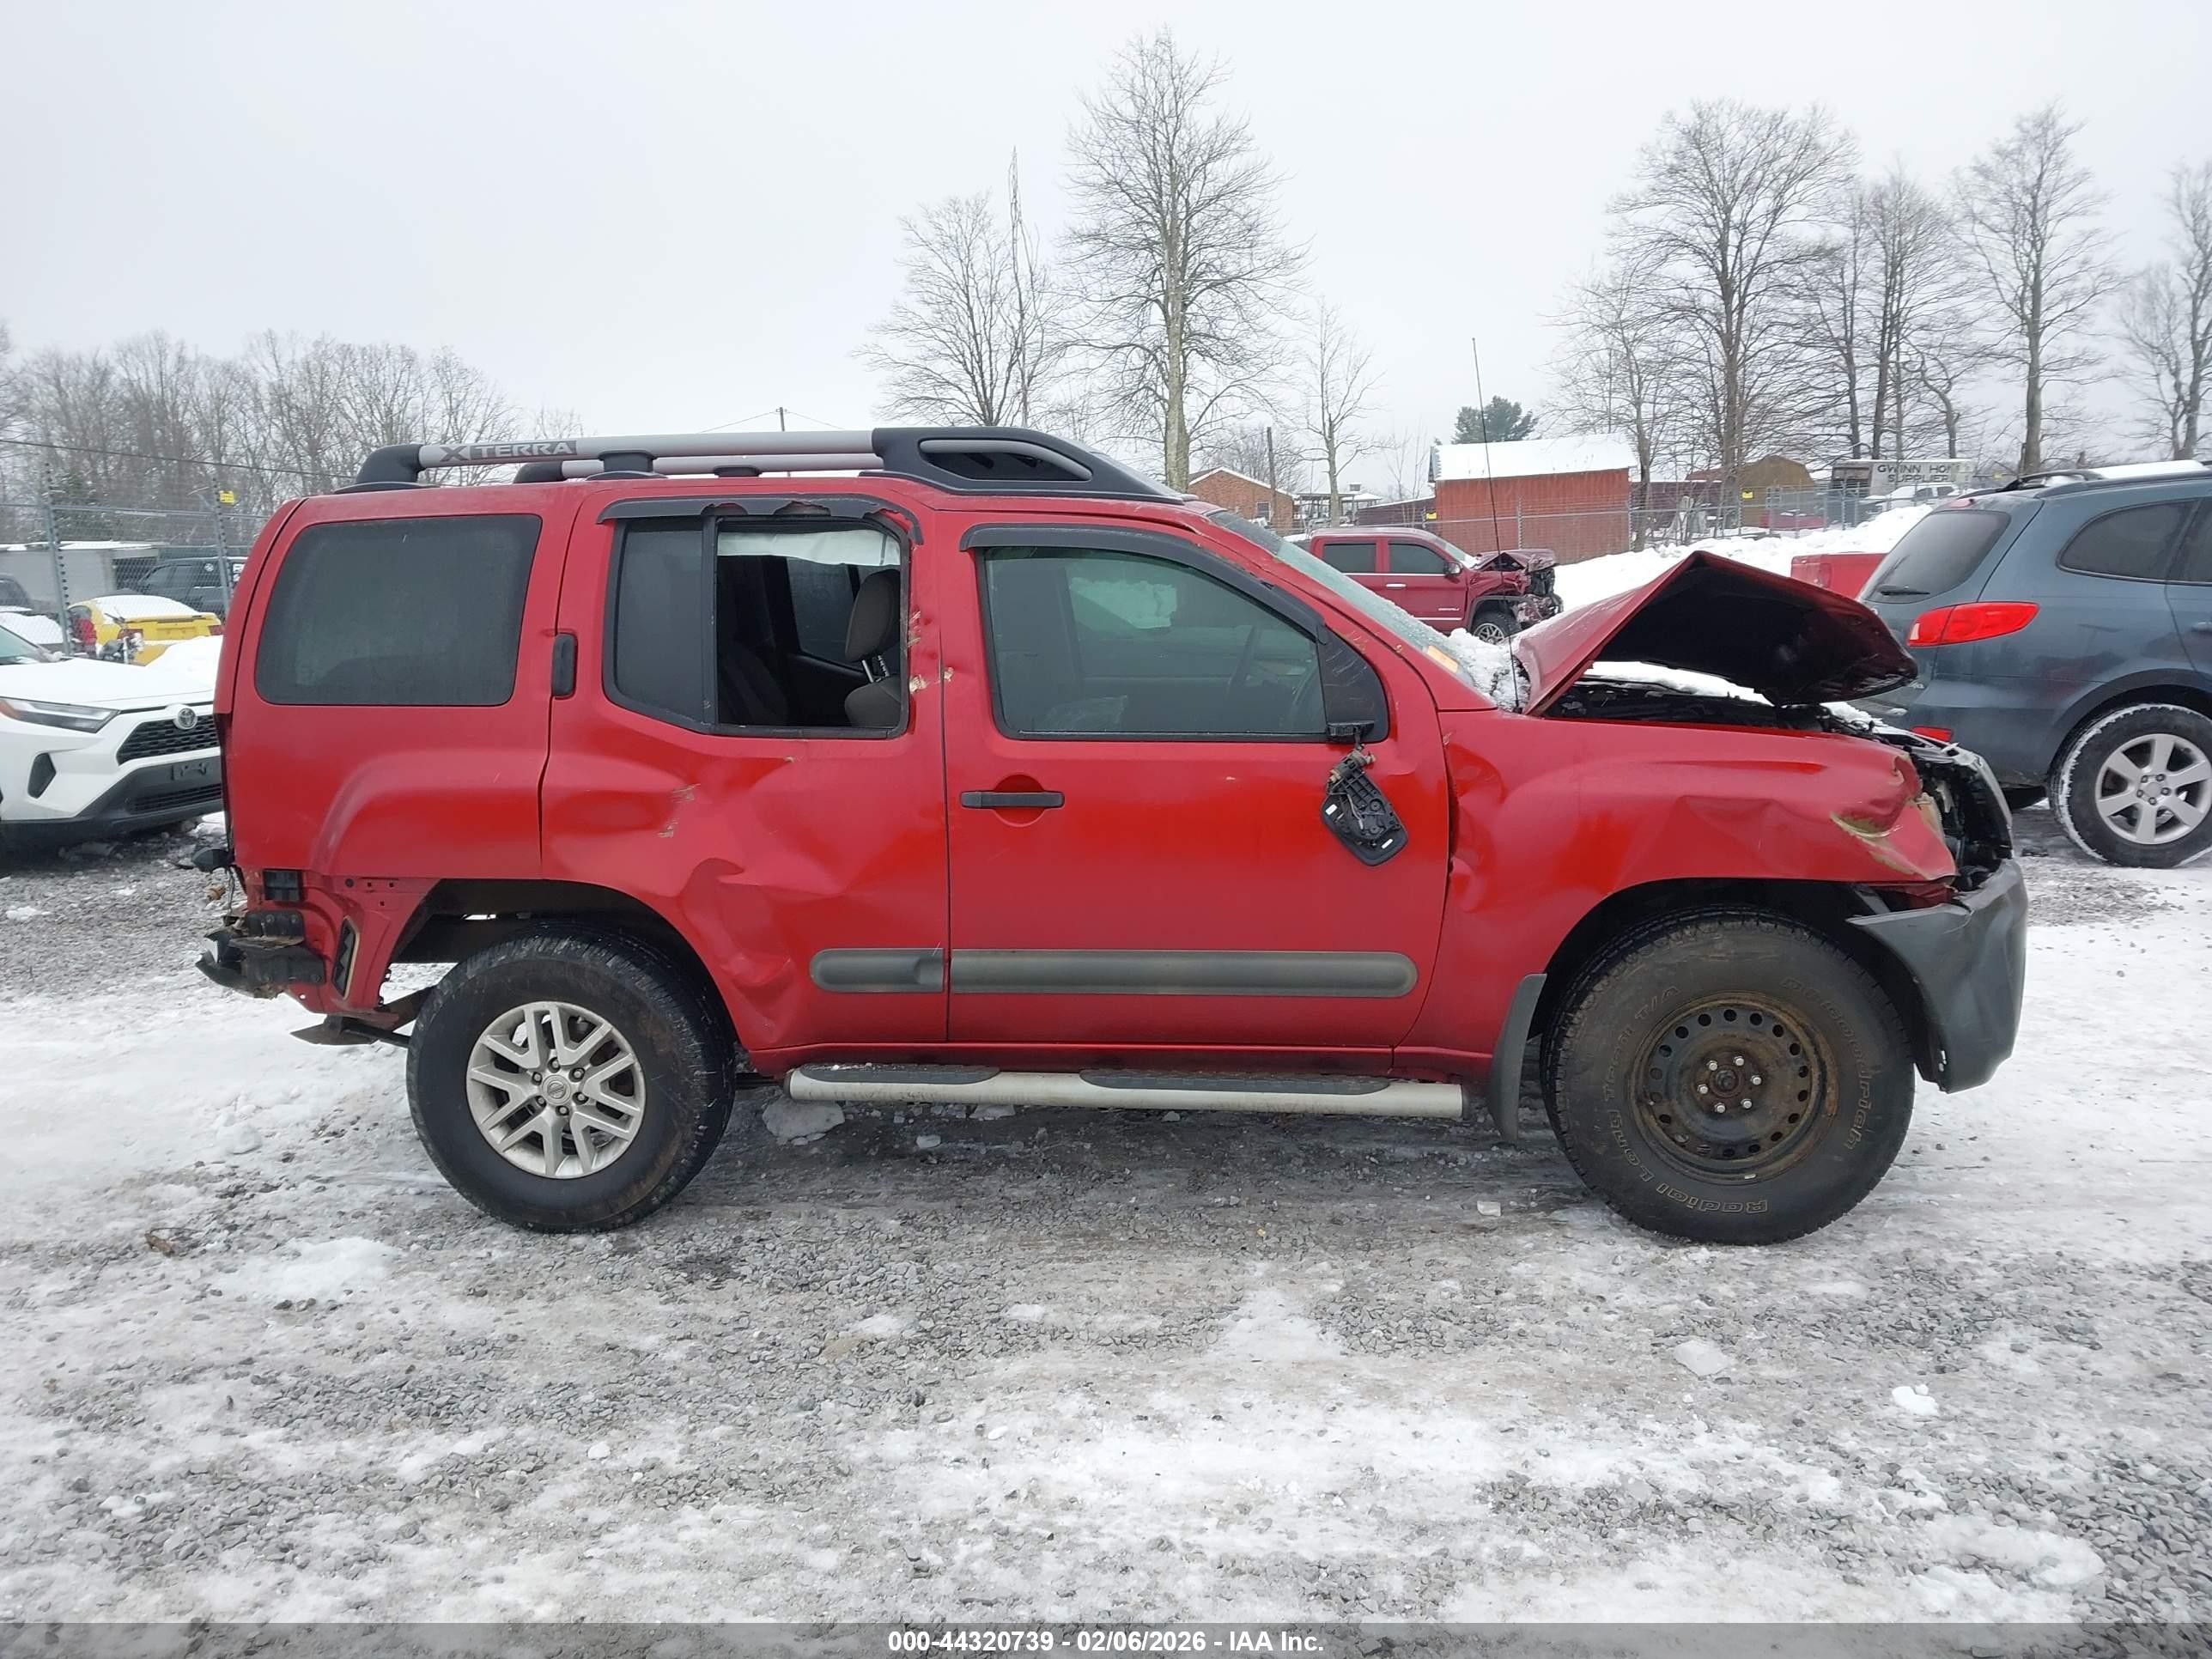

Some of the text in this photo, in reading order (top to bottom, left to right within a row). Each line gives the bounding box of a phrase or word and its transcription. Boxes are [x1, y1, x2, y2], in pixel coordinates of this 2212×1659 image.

[439, 441, 574, 462] XTERRA
[1877, 465, 1920, 473] GWINN
[1607, 1108, 1655, 1182] Long
[1656, 1182, 1768, 1214] Radial
